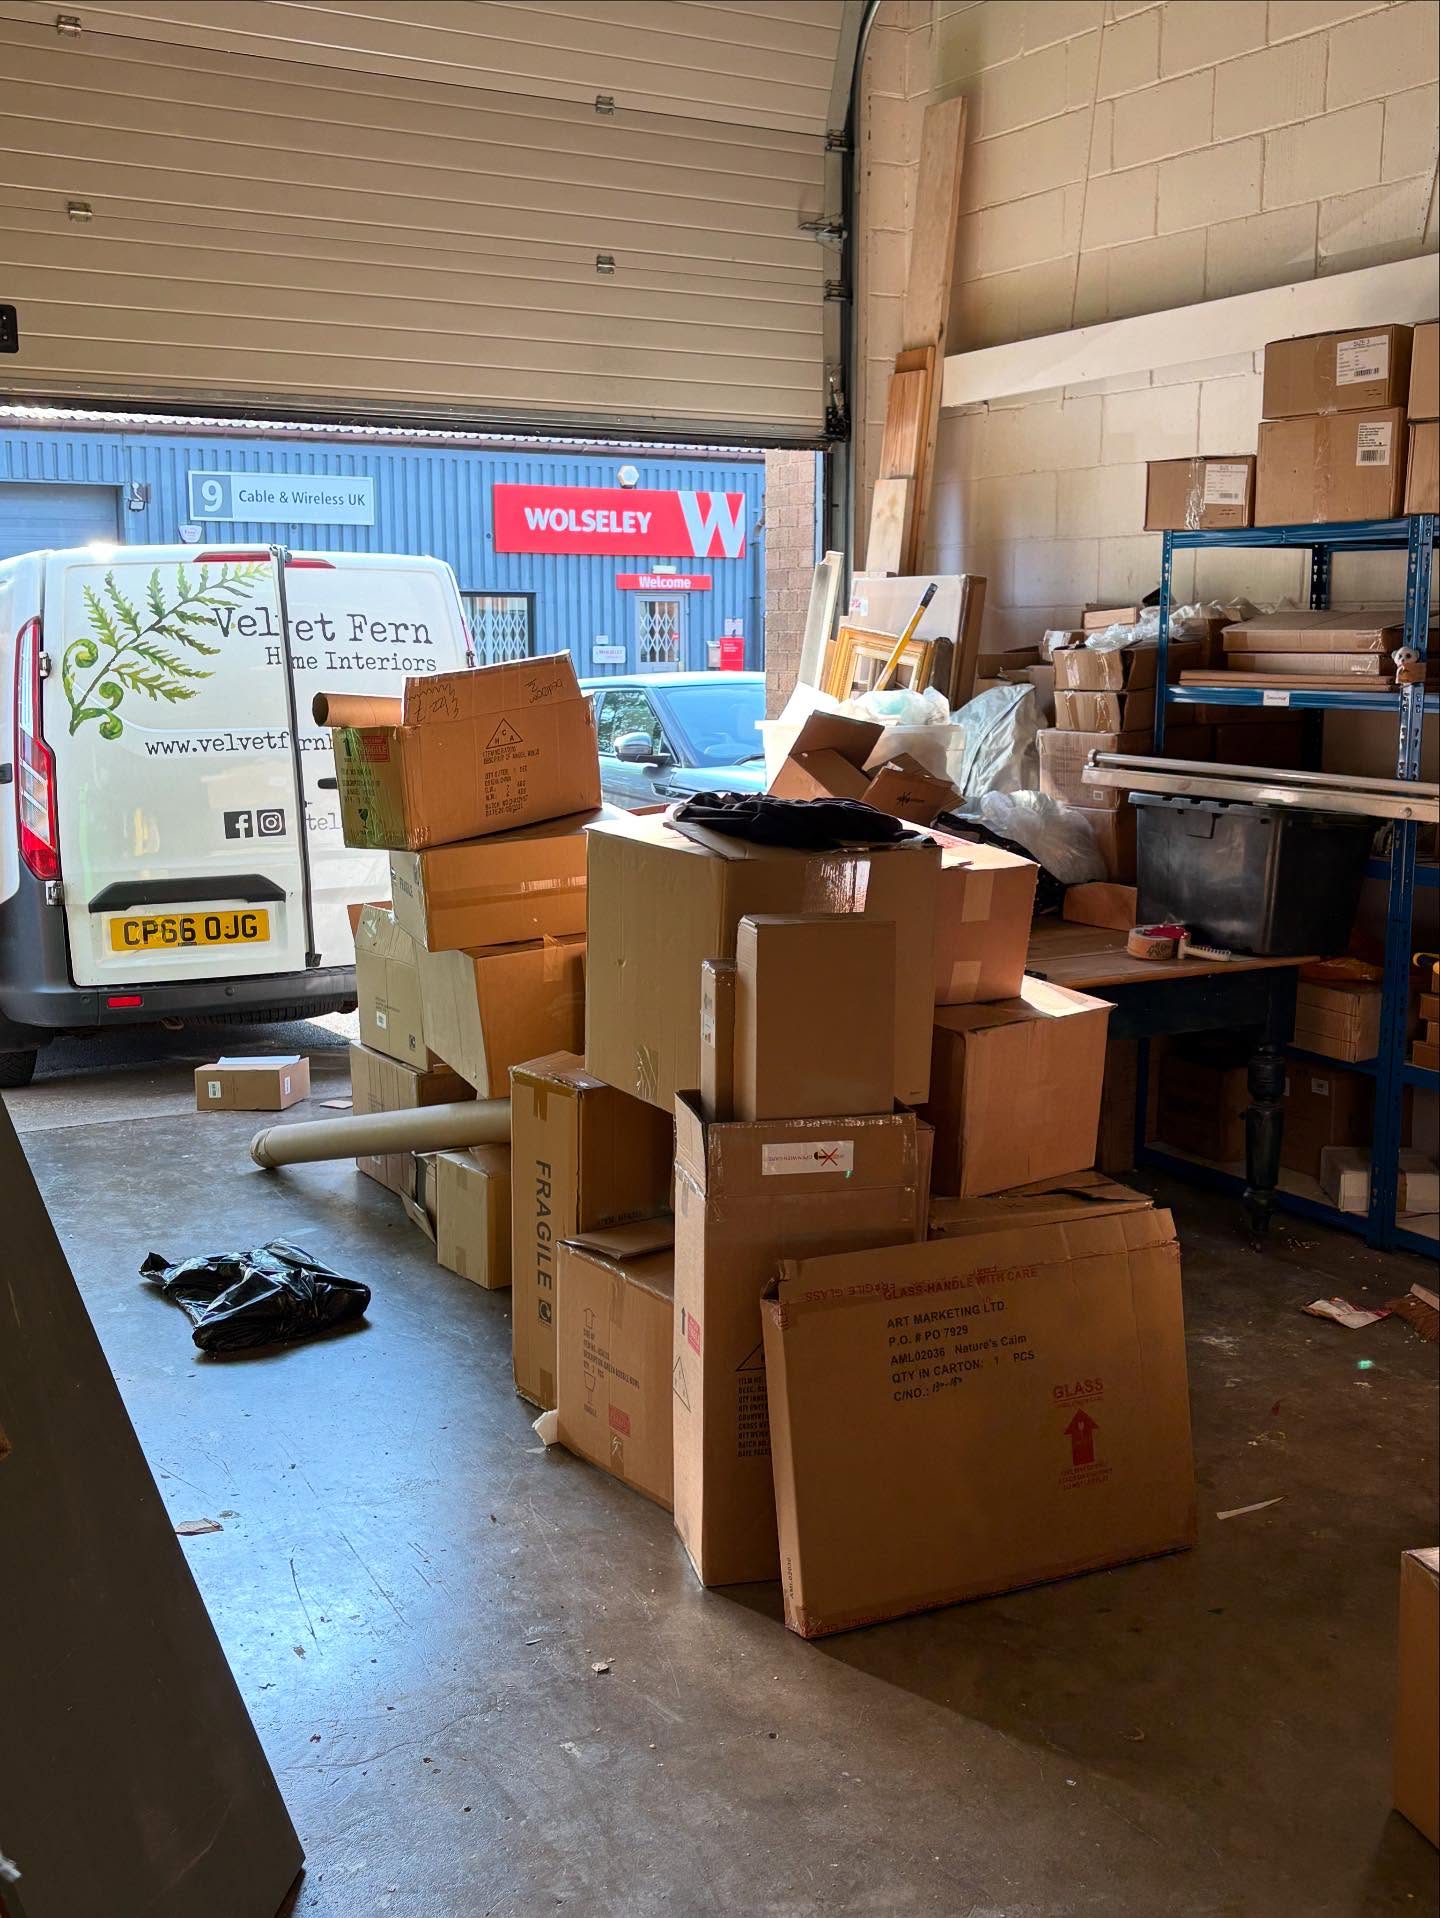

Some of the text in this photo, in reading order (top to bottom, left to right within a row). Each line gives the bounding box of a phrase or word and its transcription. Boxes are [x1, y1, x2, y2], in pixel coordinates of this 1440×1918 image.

[200, 480, 224, 512] 9
[239, 489, 365, 507] Cable & Wireless UK
[524, 507, 652, 534] WOLSELEY
[639, 576, 691, 589] Welcome
[211, 607, 433, 644] Velet Fern
[265, 647, 437, 672] Hme Interiors
[123, 914, 258, 946] CP66 OJG
[535, 1159, 552, 1291] FRAGILE
[975, 1272, 1005, 1286] WITH
[1007, 1267, 1038, 1283] CARE
[887, 1315, 910, 1328] ART
[913, 1304, 980, 1325] MARKETING
[889, 1325, 969, 1347] P.O. # PO 7929
[891, 1348, 945, 1366] AML02036
[955, 1338, 998, 1355] Nature's
[892, 1350, 1035, 1384] QTY IN CARTON: 1 PCS
[1053, 1378, 1104, 1399] GLASS
